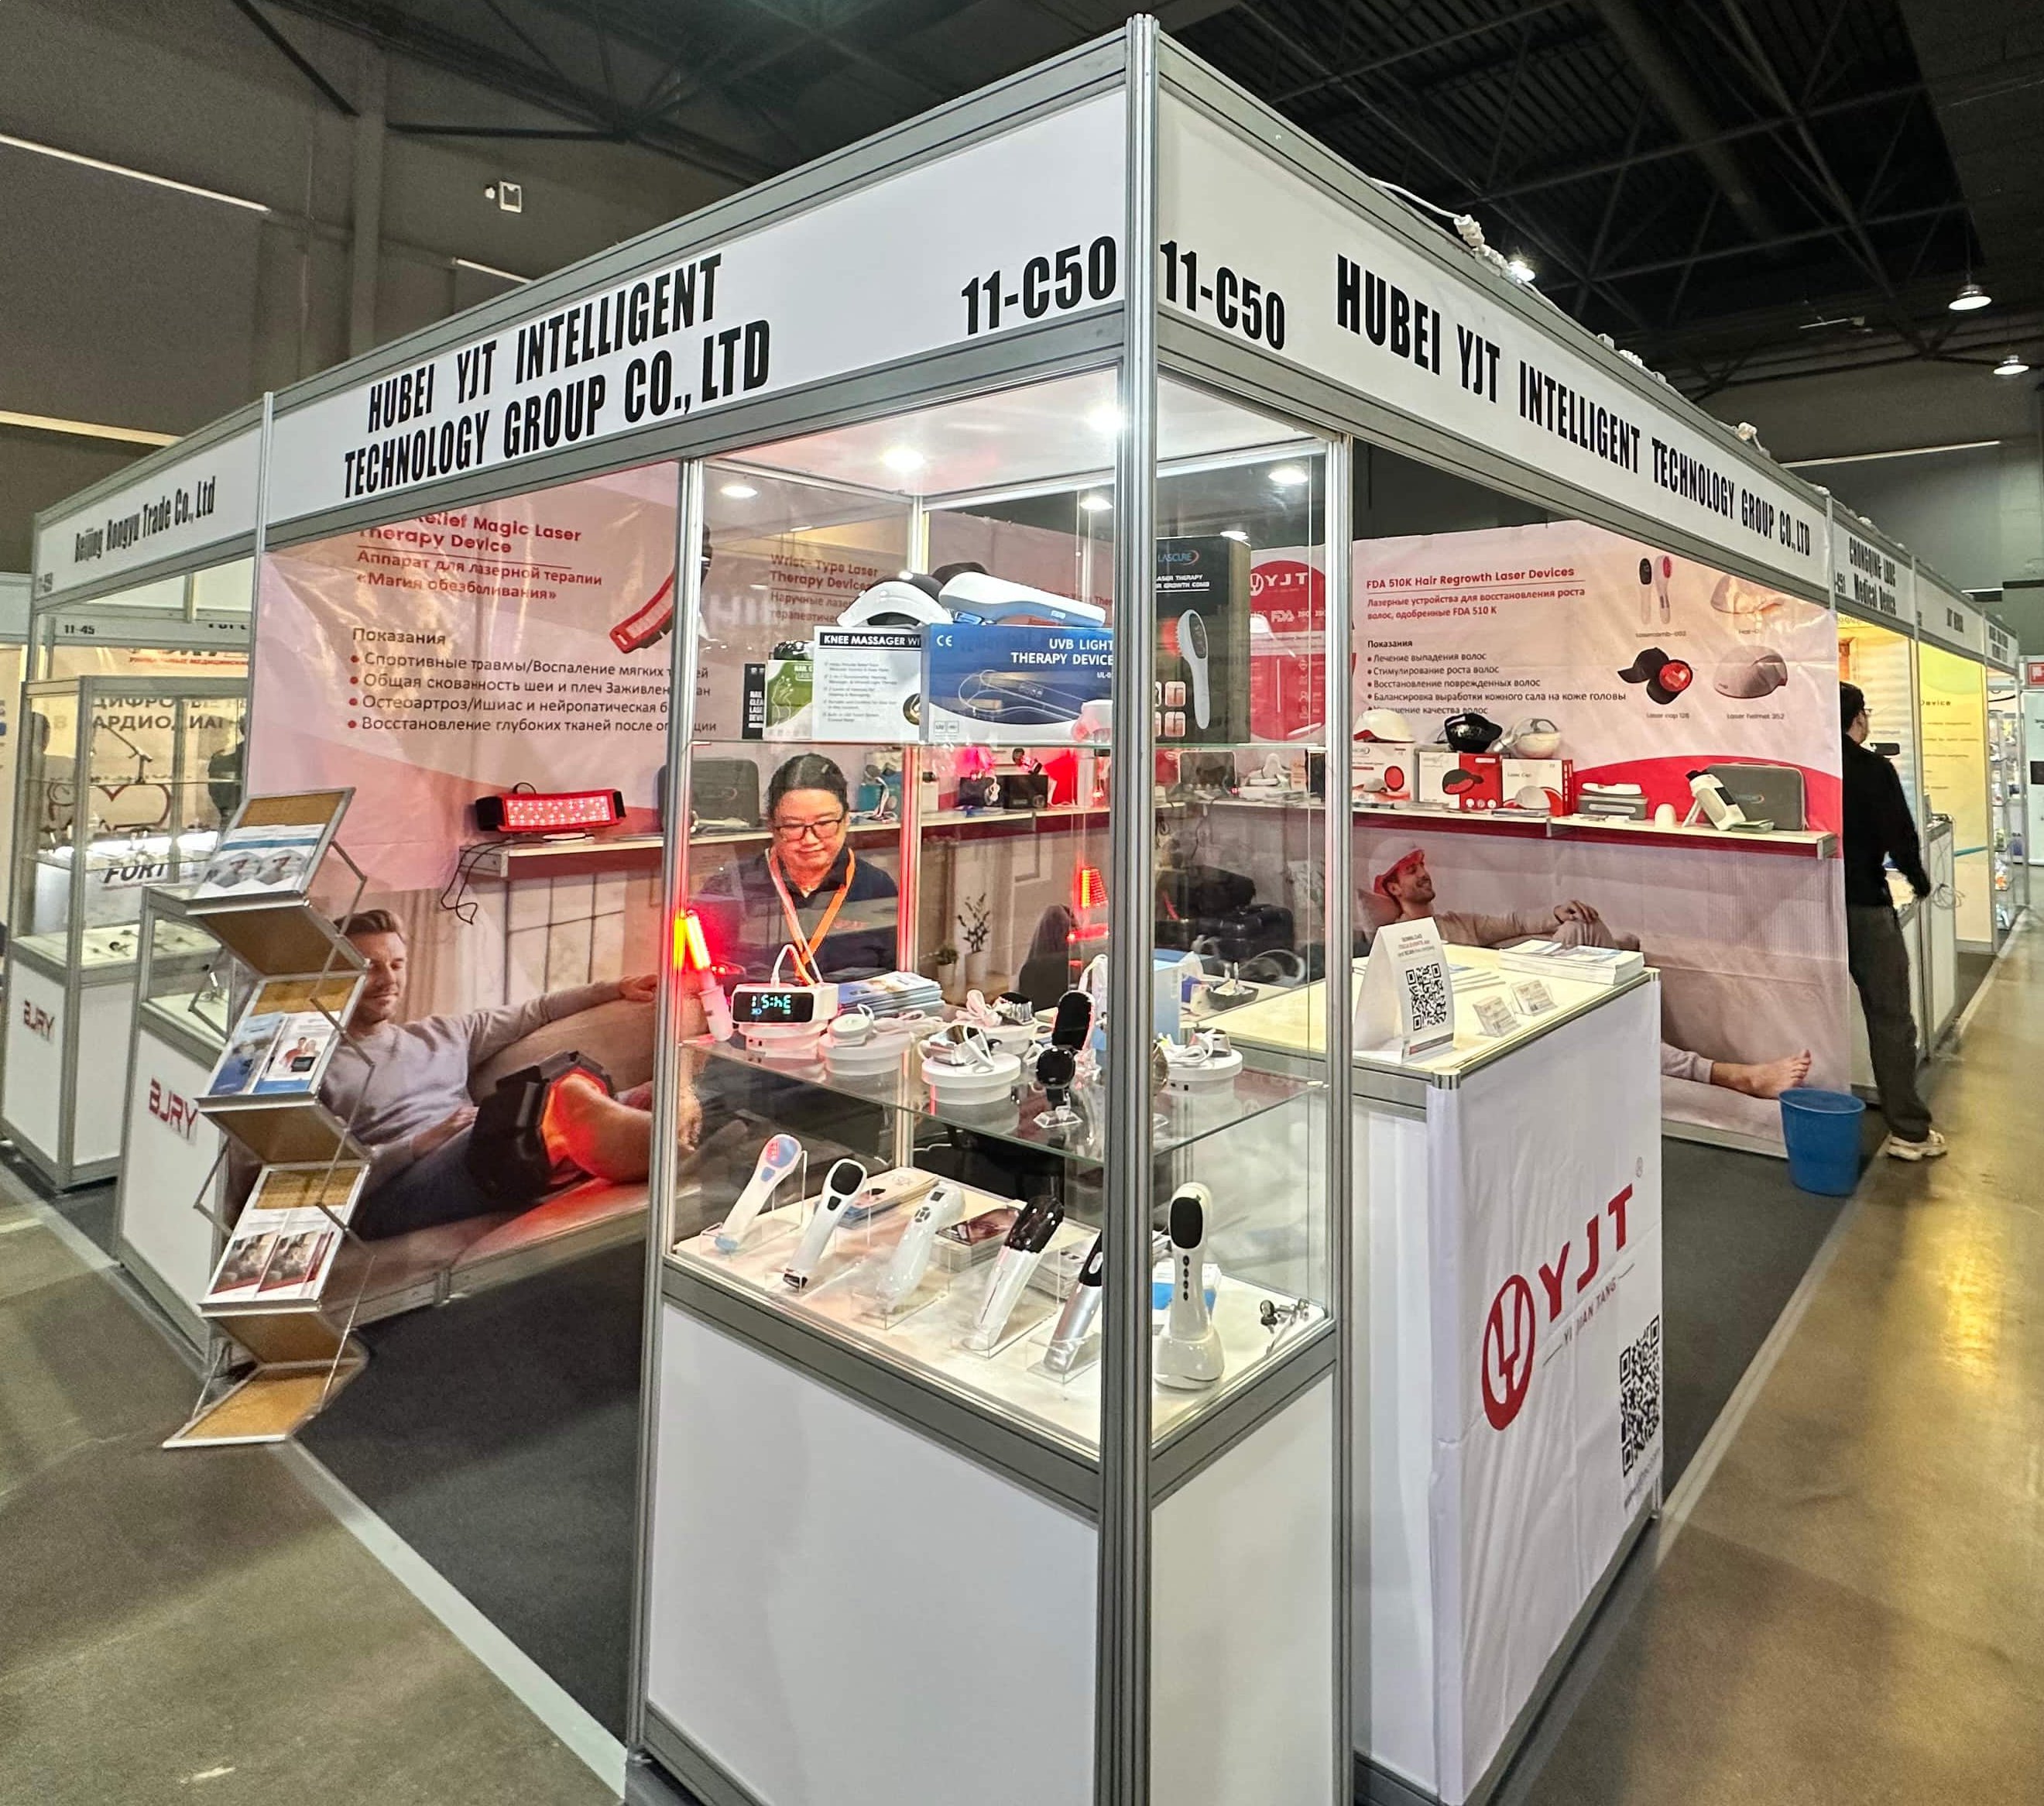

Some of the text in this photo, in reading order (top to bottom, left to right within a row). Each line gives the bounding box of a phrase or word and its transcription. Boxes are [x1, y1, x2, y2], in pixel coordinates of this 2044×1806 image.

[961, 235, 1116, 335] 11-C50
[1160, 239, 1285, 351] 11-C50
[368, 252, 722, 434] HUBEI YJT INTELLIGENT
[1336, 253, 1440, 376] HUBEI
[1457, 324, 1500, 403] YJT
[1518, 360, 1641, 474] INTELLIGENT
[1651, 436, 1735, 520] TECHNOLOGY
[1741, 488, 1775, 540] GROUP
[344, 319, 770, 499] TECHNOLOGY GROUP CO., LTD
[142, 496, 171, 538] Trade
[195, 476, 216, 519] Ltd
[416, 512, 582, 541] elief Magic Laser
[451, 534, 512, 553] Device
[357, 550, 602, 585] Аппарат для лазерной терапии
[816, 559, 845, 575] Type
[848, 563, 879, 577] Laser
[770, 570, 824, 589] Therapy
[1264, 572, 1308, 587] YJT
[1367, 567, 1575, 589] FDA 510K Hair Regrowth Laser Devices
[1367, 588, 1586, 608] Лазерные устройства для восстановления роста
[1271, 609, 1295, 623] FDA
[1395, 609, 1451, 620] одобренные
[1452, 607, 1470, 616] FDA
[1472, 606, 1489, 616] 510
[352, 627, 446, 645] Показания
[824, 635, 921, 646] KNEE MASSAGER WI
[1049, 638, 1113, 651] UVB LIGHT
[1367, 640, 1413, 648] Показания
[365, 651, 467, 668] Спортивные
[470, 659, 616, 675] травмы/Воспаление
[619, 668, 664, 678] мягких
[1010, 651, 1113, 665] THERAPY DEVICE
[1374, 654, 1409, 663] Лечение
[1411, 654, 1459, 663] выпадения
[1374, 667, 1445, 676] Стимулирование
[1473, 665, 1500, 674] волос
[363, 673, 421, 688] Общая
[427, 678, 520, 691] скованность
[524, 682, 554, 692] шеи
[558, 683, 567, 692] и
[571, 684, 602, 693] плеч
[606, 682, 670, 695] Заживлен
[1374, 679, 1442, 688] Восстановление
[1444, 680, 1511, 688] поврежденных
[362, 695, 523, 712] Остеоартроз/Ишиас
[526, 702, 535, 711] и
[540, 699, 656, 714] нейропатическая
[1374, 692, 1432, 701] Балансировка
[1435, 692, 1483, 702] выработки
[1562, 692, 1587, 701] коже
[1590, 692, 1627, 701] головы
[362, 716, 491, 730] Восстановление
[496, 718, 561, 733] глубоких
[565, 719, 611, 731] тканей
[615, 722, 653, 731] после
[149, 1078, 198, 1141] BJRY
[1538, 1183, 1633, 1324] YJT
[1596, 1276, 1617, 1309] TANG
